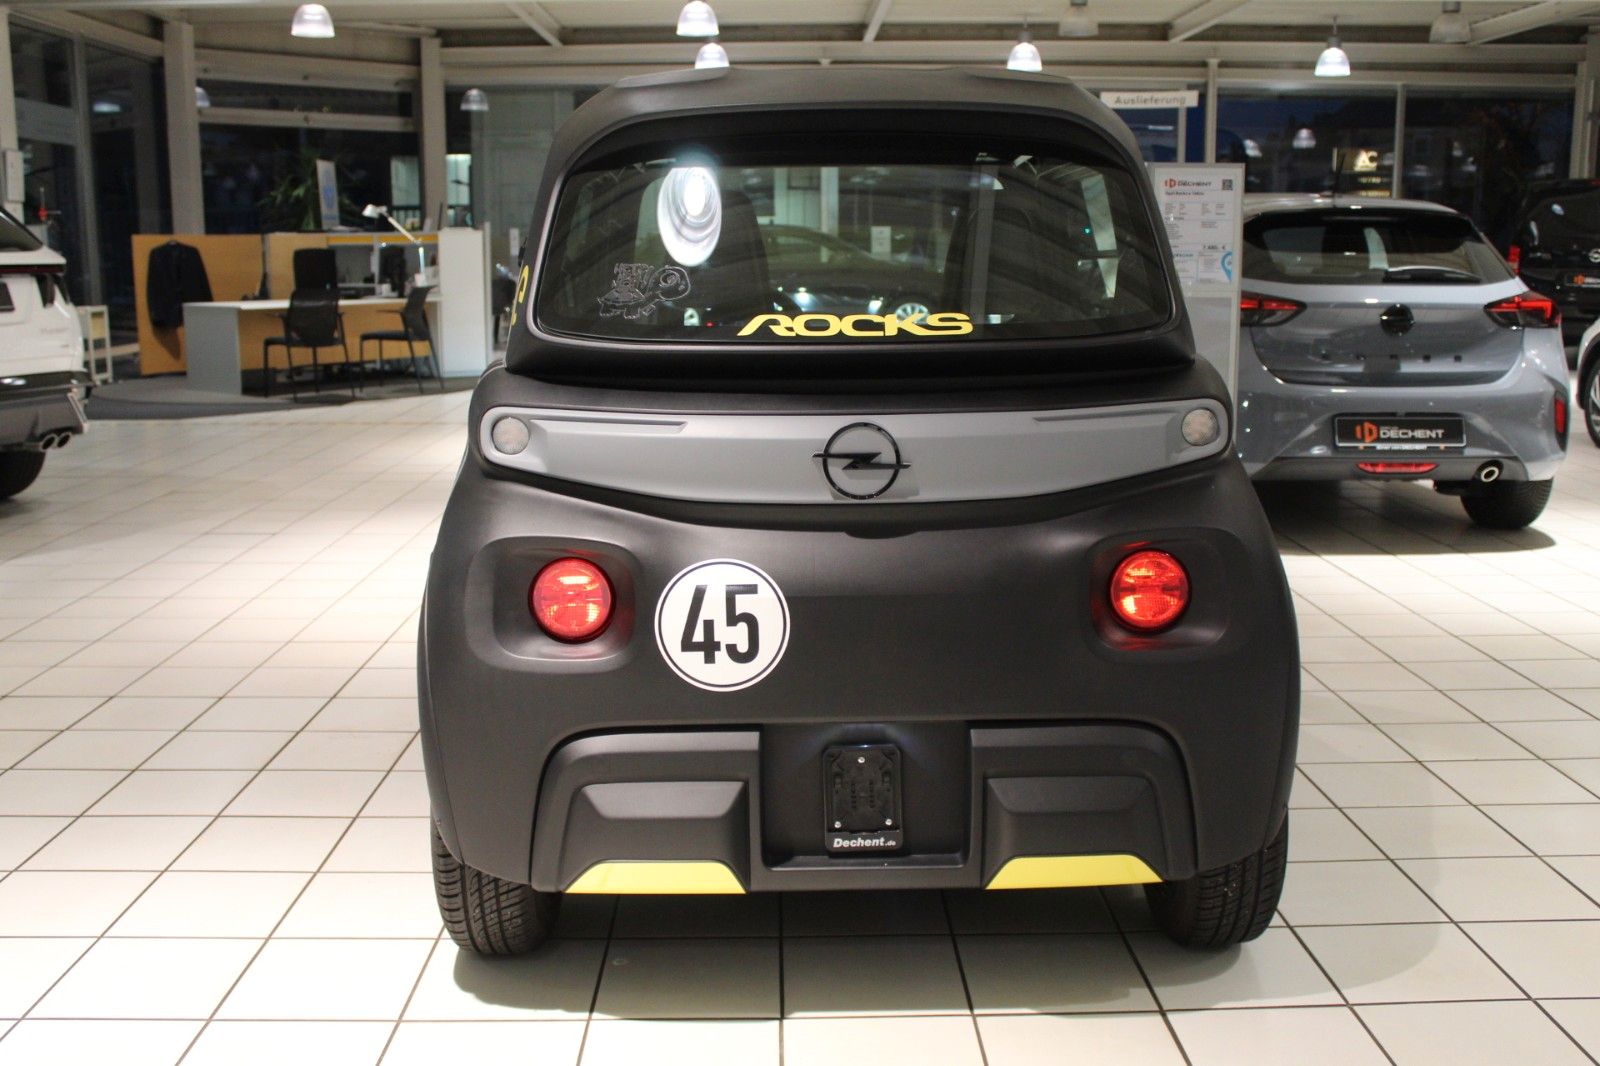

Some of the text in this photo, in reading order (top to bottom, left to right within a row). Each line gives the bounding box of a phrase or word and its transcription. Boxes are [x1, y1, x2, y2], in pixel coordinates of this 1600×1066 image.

[1114, 95, 1187, 106] Auslieferung
[736, 312, 974, 337] ROCKS
[1380, 429, 1445, 439] DECHENT
[680, 583, 760, 665] 45
